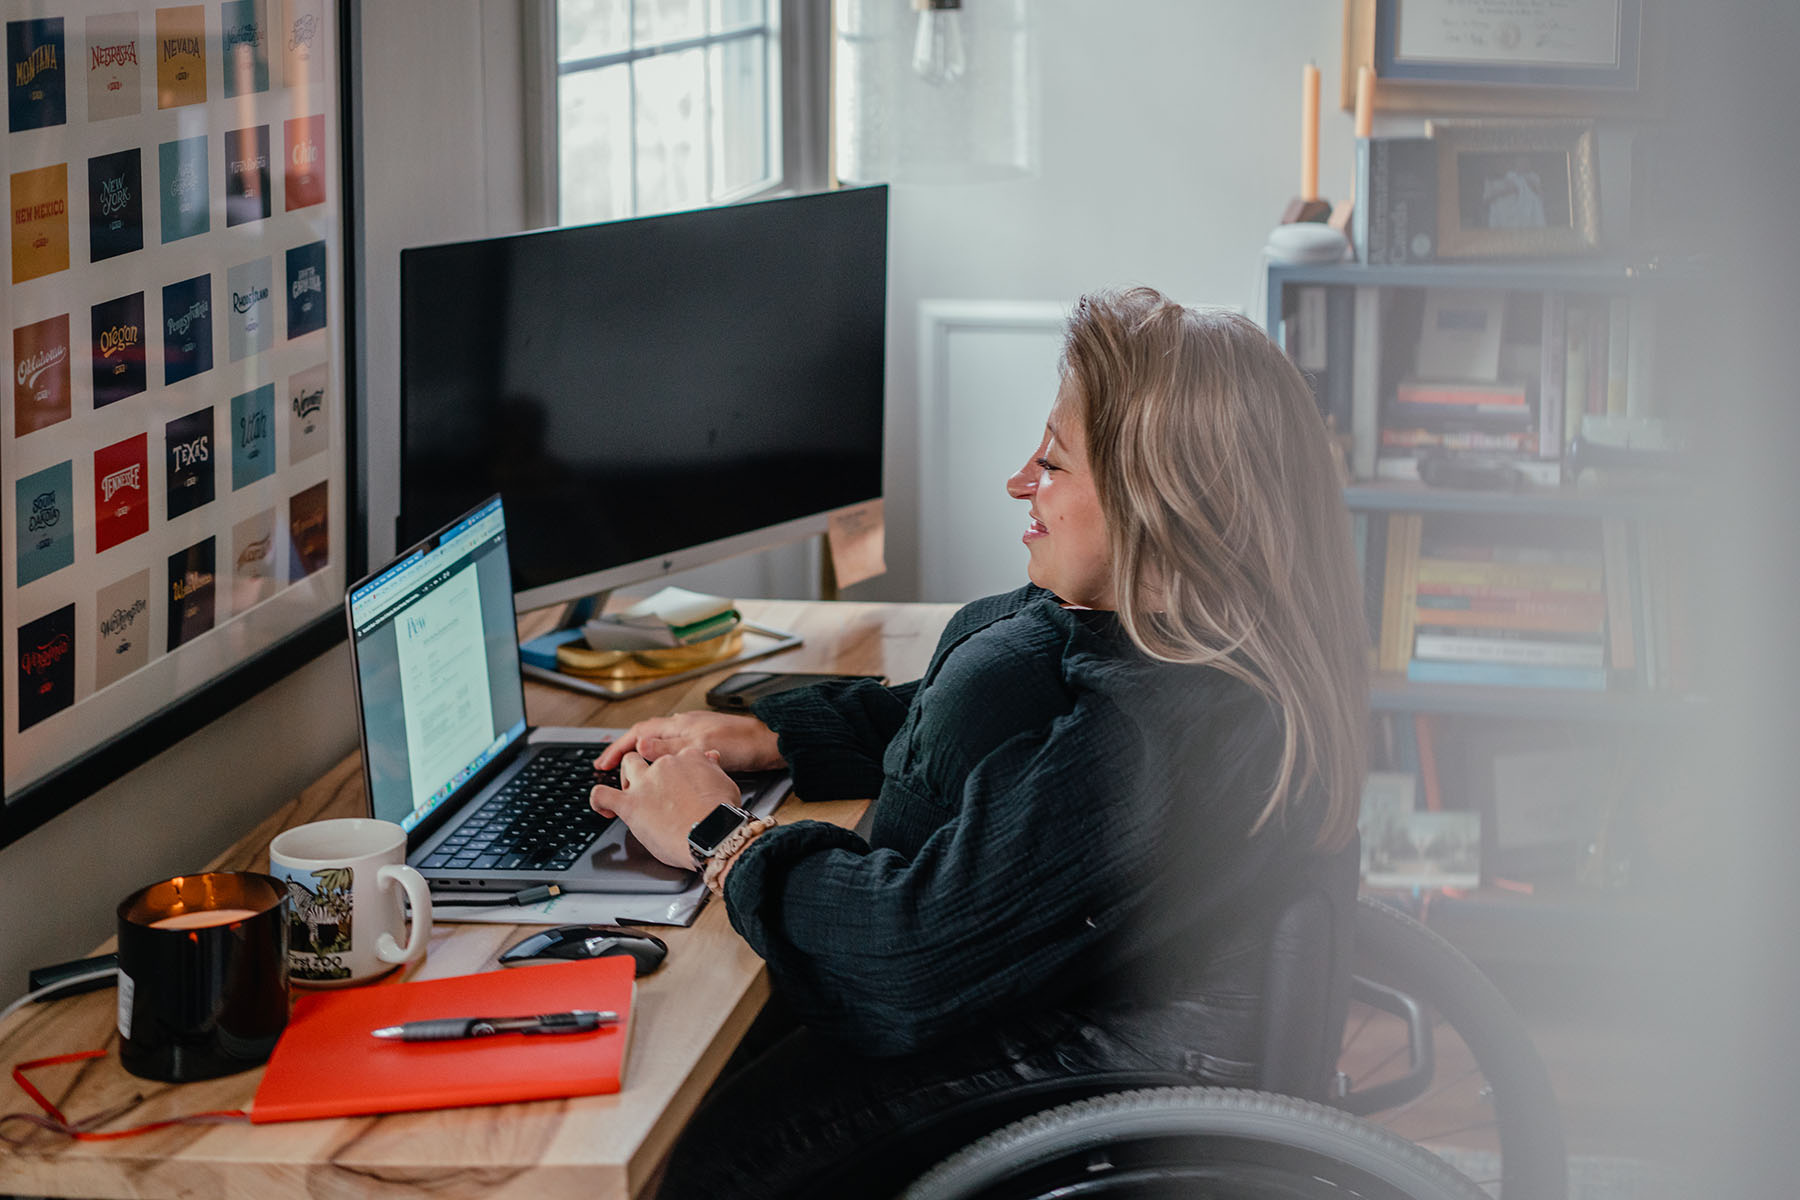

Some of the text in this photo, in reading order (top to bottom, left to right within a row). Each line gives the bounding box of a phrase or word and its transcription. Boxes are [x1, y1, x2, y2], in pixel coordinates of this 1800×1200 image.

[91, 41, 138, 71] NEBRASKA
[163, 35, 201, 63] NEVADA
[16, 44, 57, 87] MONTANA
[103, 173, 125, 195] NEW
[15, 199, 65, 225] NEW MEXICO
[100, 186, 131, 216] YORK
[100, 324, 138, 358] Oregon
[101, 463, 141, 502] TENNESSEE
